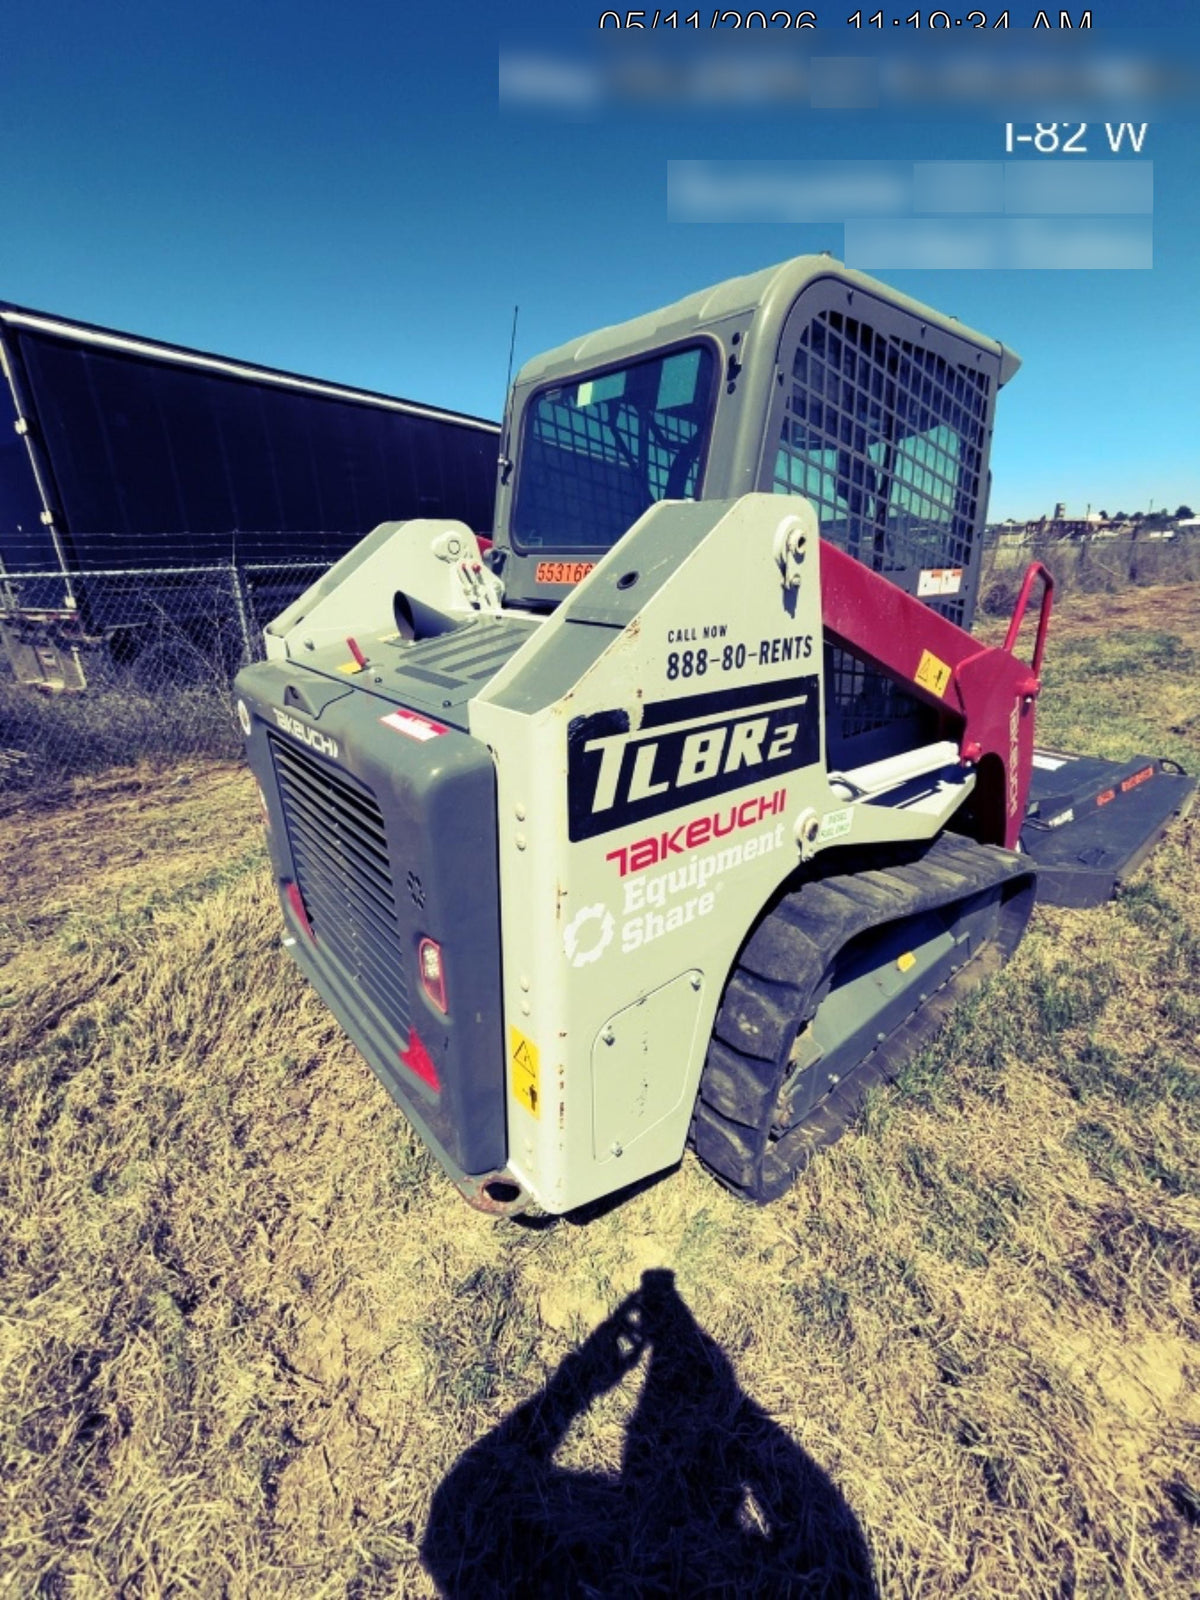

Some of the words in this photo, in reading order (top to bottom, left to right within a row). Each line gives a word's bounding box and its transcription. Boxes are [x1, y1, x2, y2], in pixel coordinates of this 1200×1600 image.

[667, 635, 813, 680] 888-80-RENTS
[668, 628, 697, 643] CALL
[703, 624, 728, 638] NOW
[605, 788, 787, 877] TAKEUCHI
[622, 823, 785, 915] Equipment
[621, 889, 715, 954] Share
